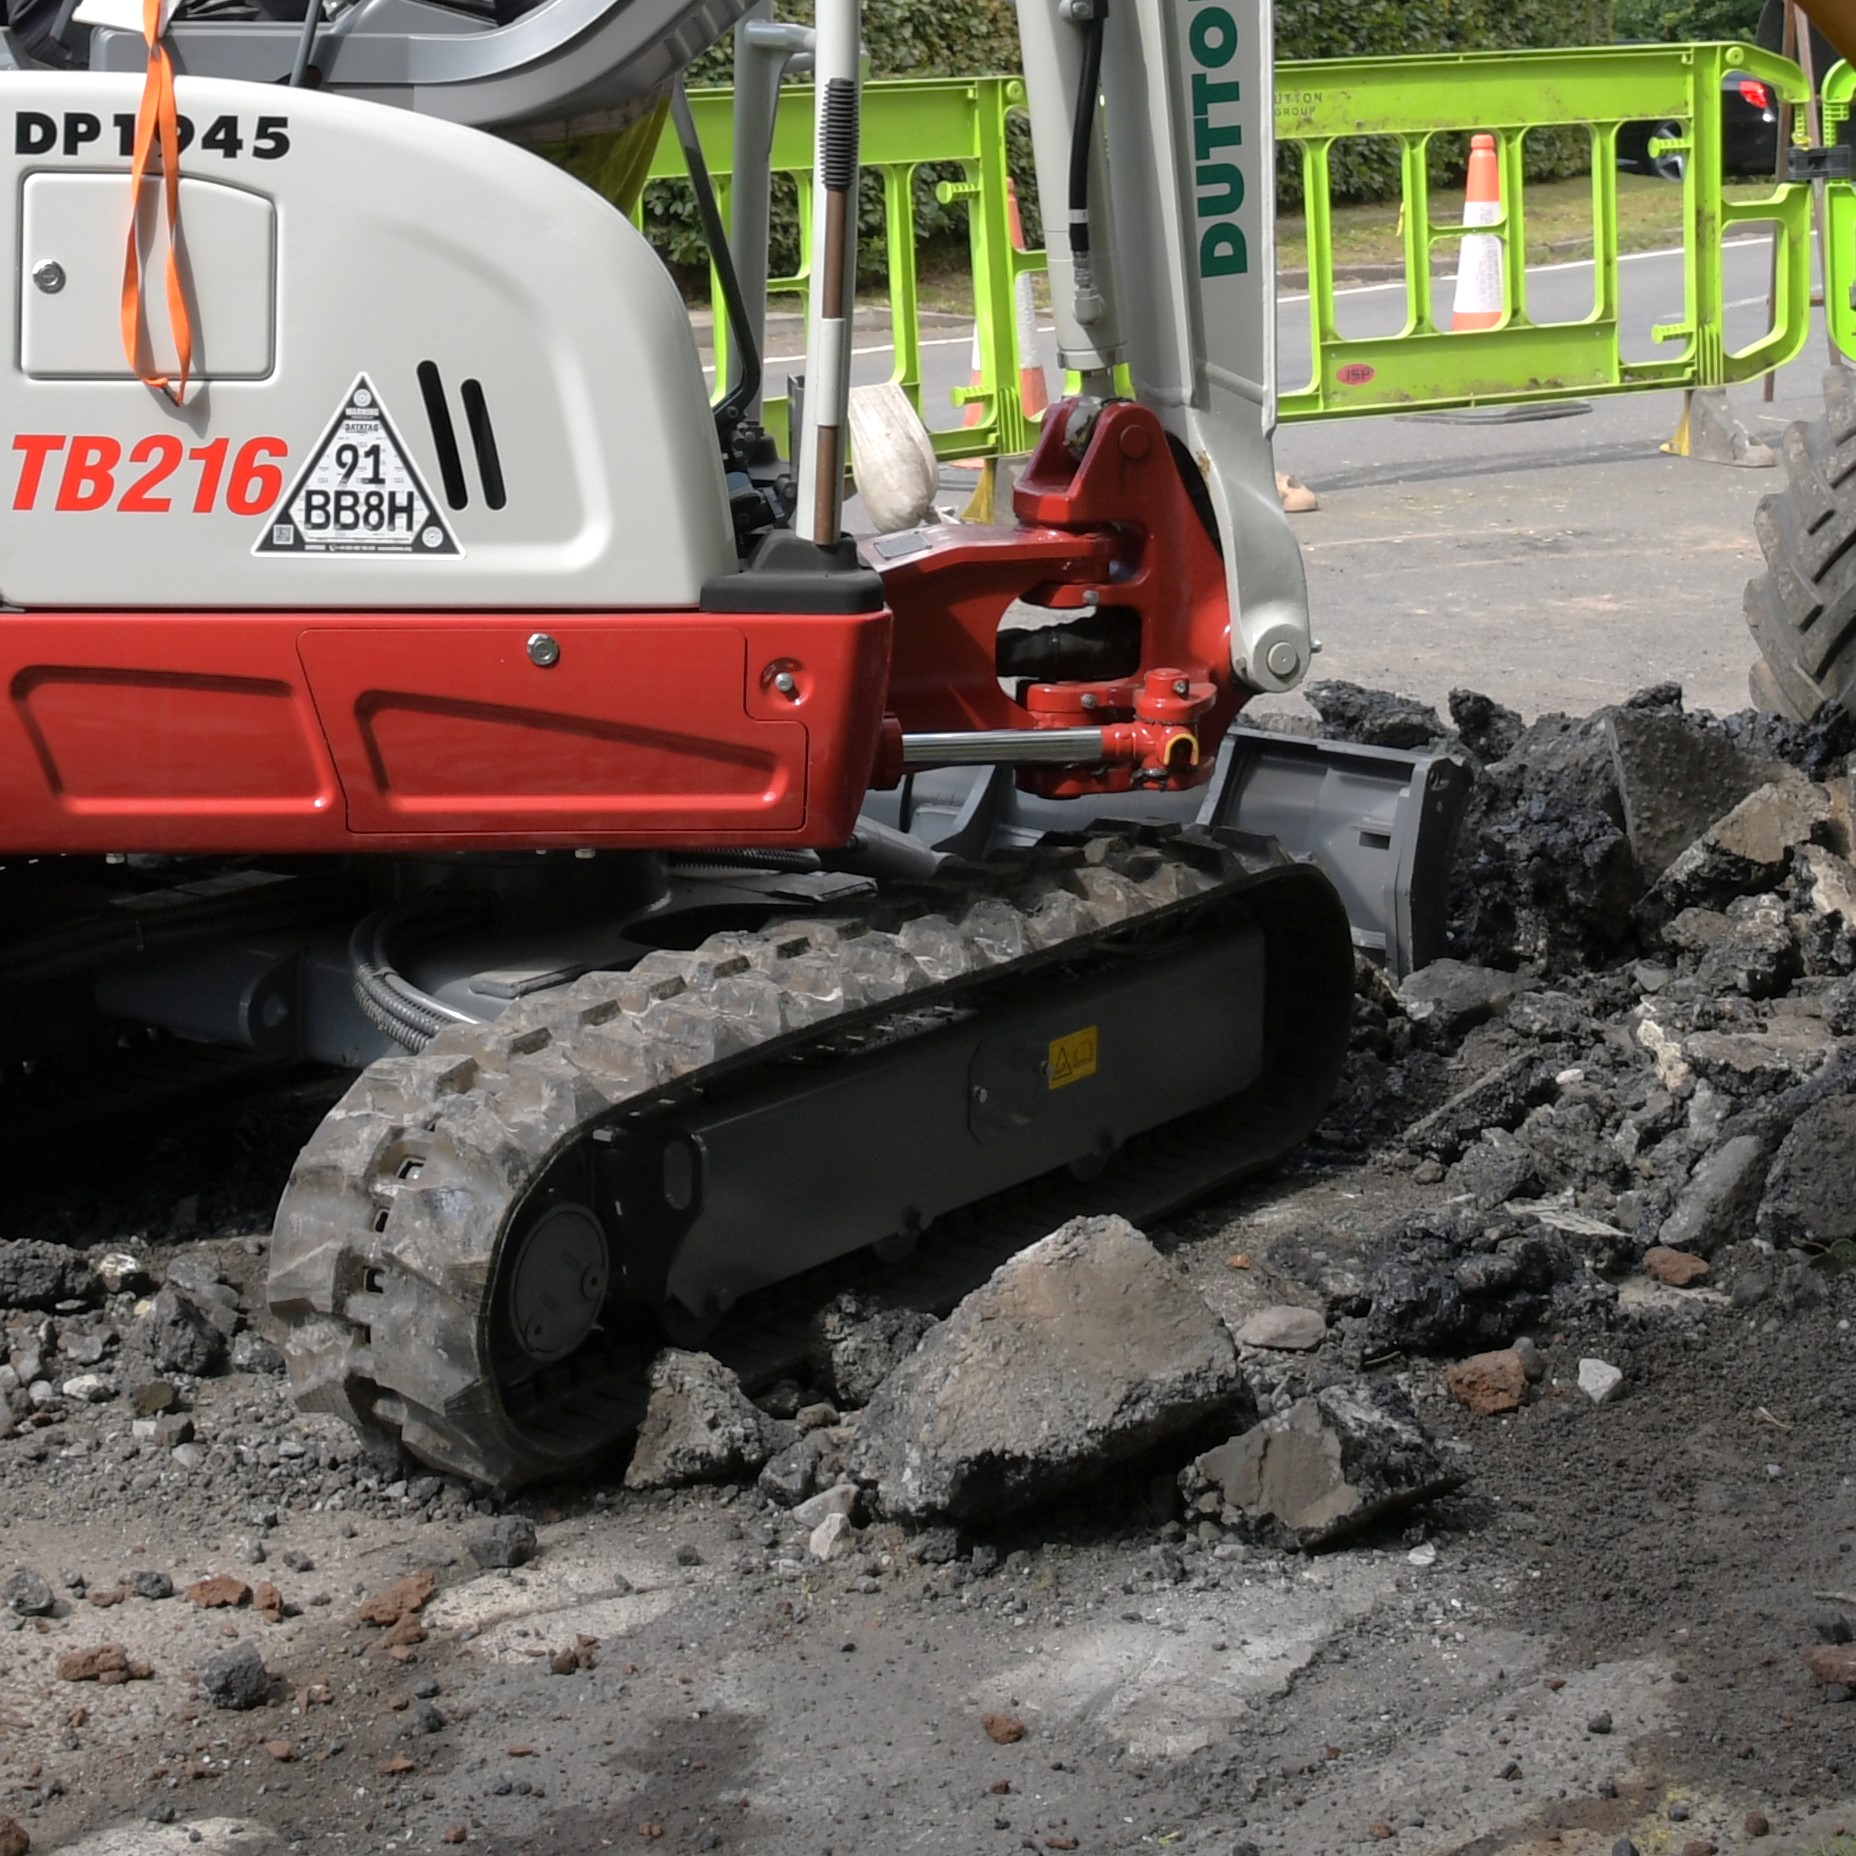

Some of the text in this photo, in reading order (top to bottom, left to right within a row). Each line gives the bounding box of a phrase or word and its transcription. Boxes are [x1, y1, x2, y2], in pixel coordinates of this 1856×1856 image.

[1275, 92, 1323, 104] UTTON
[11, 434, 289, 516] TB216
[335, 443, 386, 486] 91
[304, 489, 415, 532] BB8H
